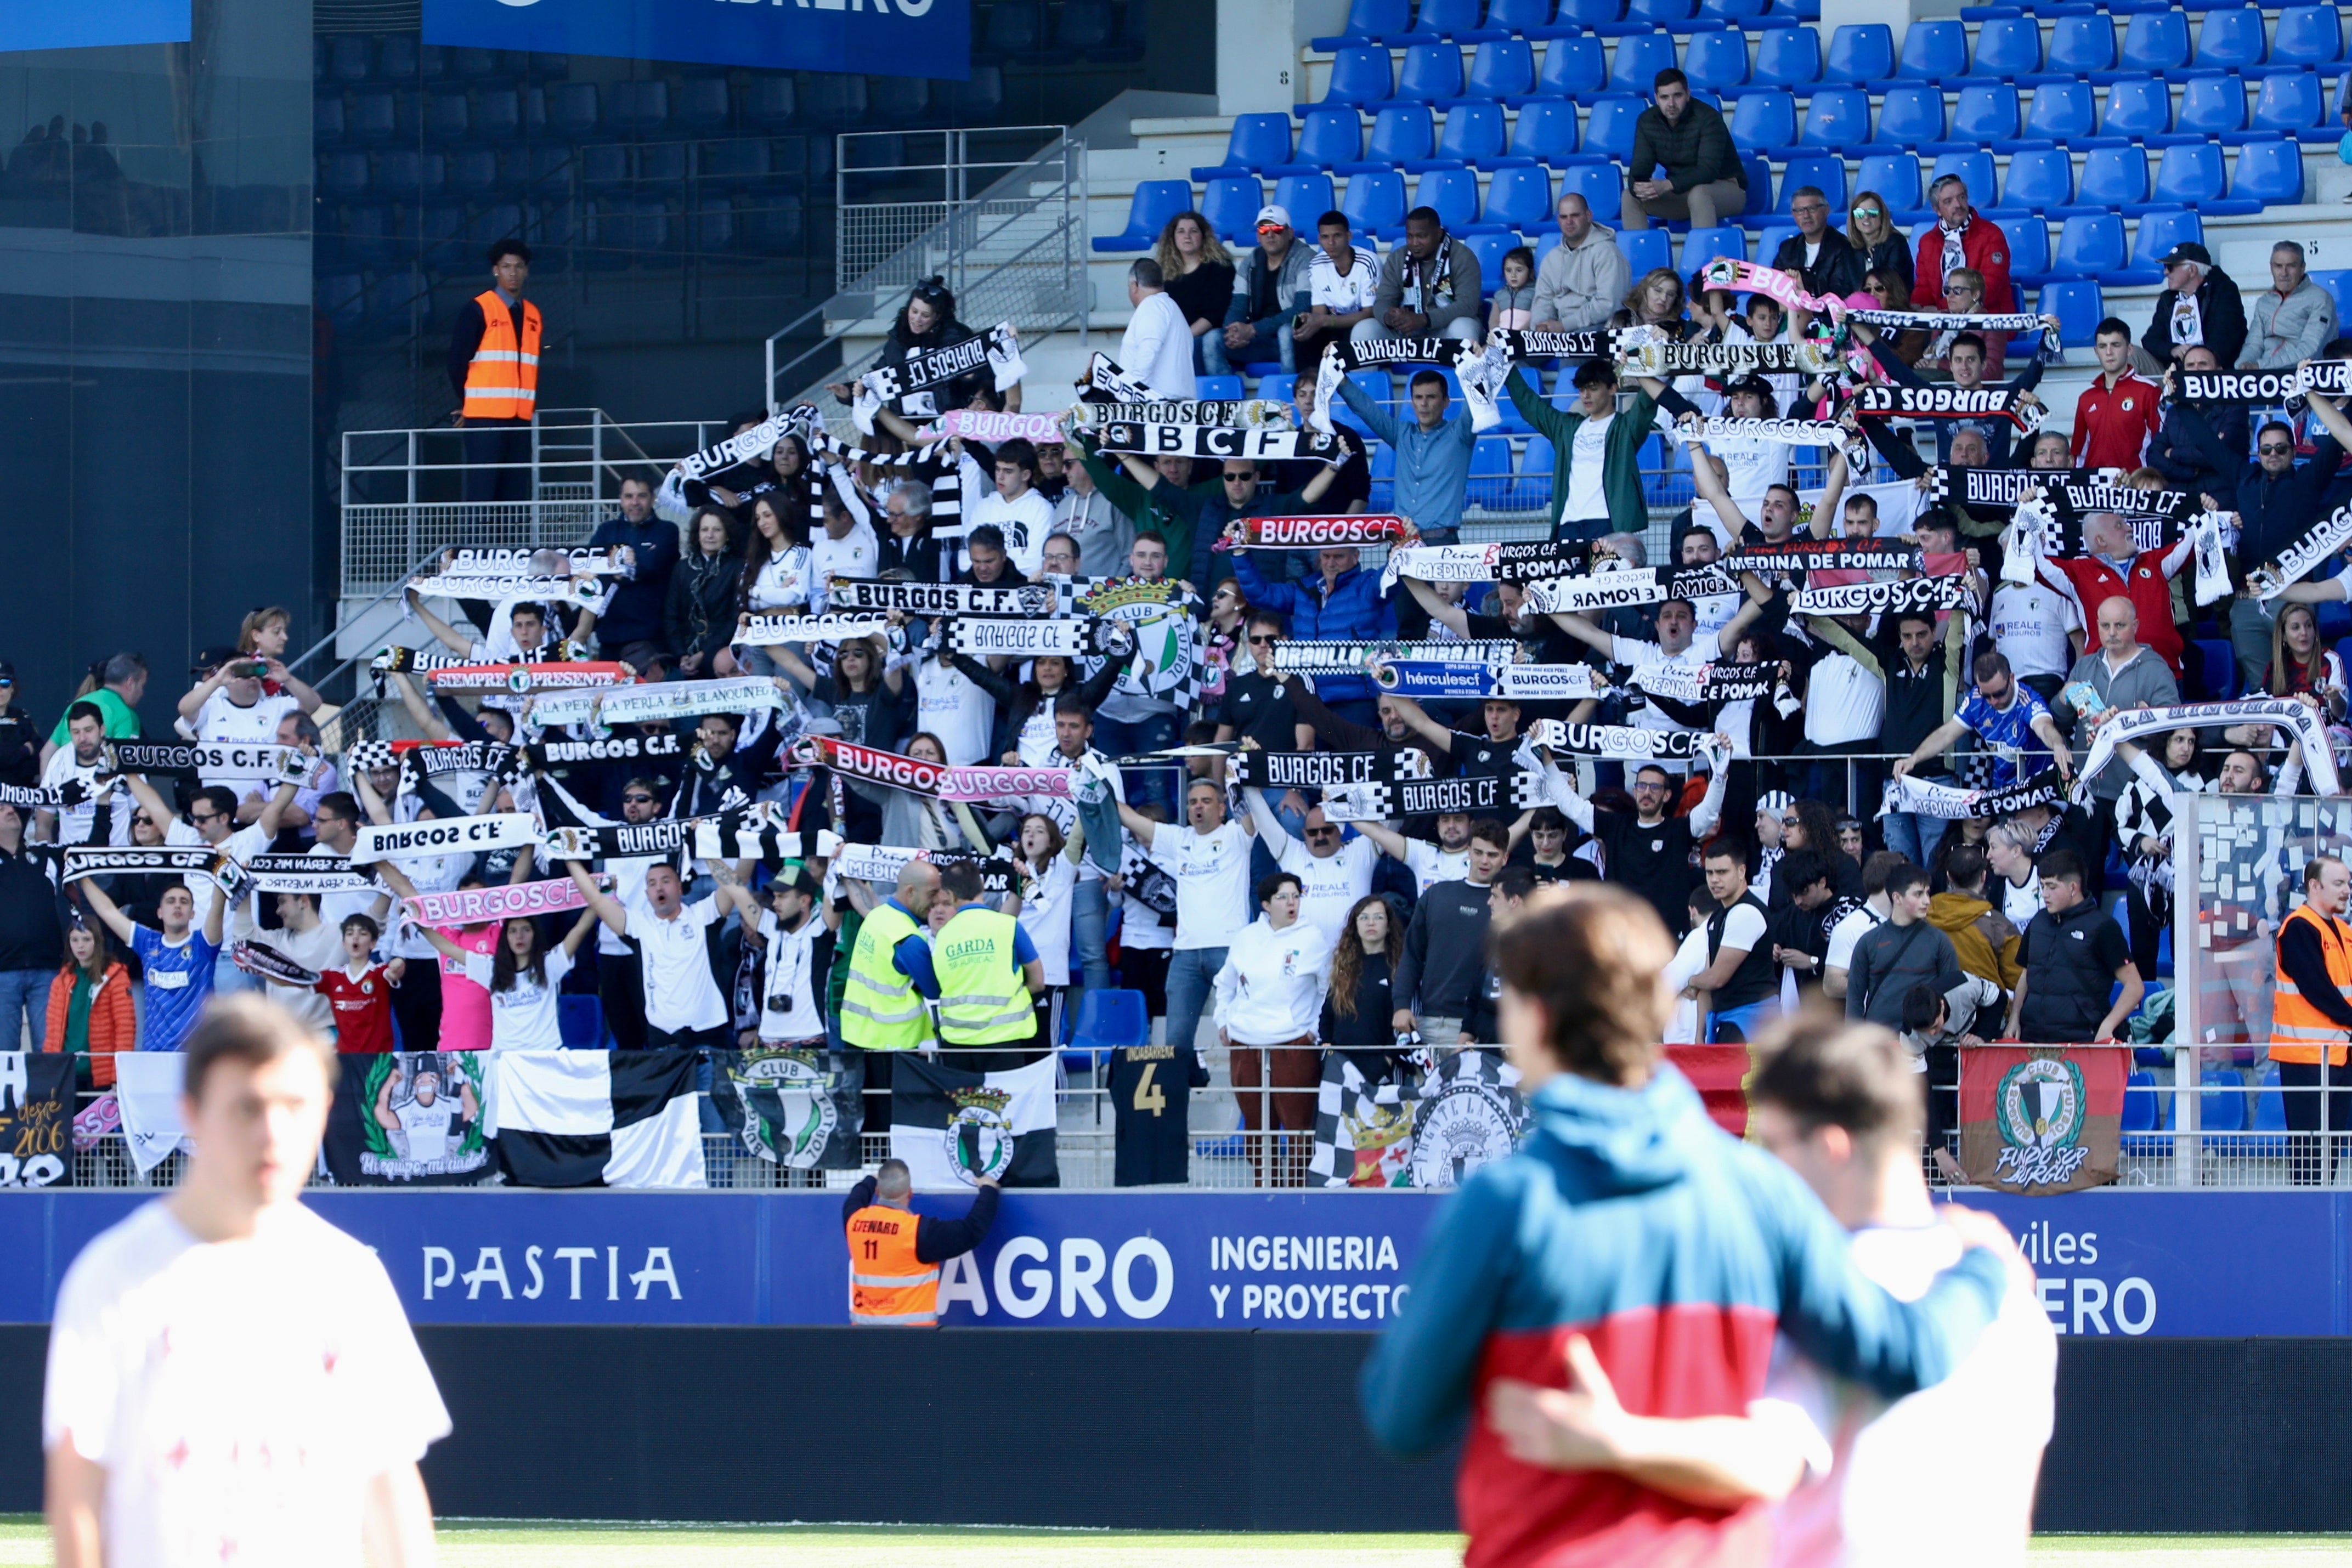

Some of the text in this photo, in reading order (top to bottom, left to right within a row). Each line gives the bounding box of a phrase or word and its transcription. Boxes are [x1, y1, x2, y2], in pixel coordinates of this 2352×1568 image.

[1520, 331, 1577, 353] BURGOS
[908, 337, 986, 388] BURGOS CF
[1864, 387, 2009, 411] BURGOS CF
[957, 410, 1060, 435] BURGOS
[1727, 452, 1759, 461] REALE
[2066, 485, 2186, 514] BURGOS CF
[1442, 547, 1482, 559] Peña
[1483, 545, 1538, 565] BURGOS
[1729, 552, 1909, 571] MEDINA DE POMAR
[1416, 562, 1488, 579] MEDINA
[1517, 556, 1581, 579] POMAR
[857, 584, 1014, 612] BURGOS C.F.
[1112, 605, 1153, 620] CLUB
[2008, 621, 2042, 630] REALE
[1168, 623, 1189, 679] FUTBOL
[1274, 646, 1365, 667] ORGULLO
[437, 672, 507, 689] SIEMPRE
[530, 671, 616, 688] PRESENTE
[1638, 673, 1697, 698] MEDINA
[543, 700, 562, 713] LA
[565, 697, 594, 713] PER
[604, 684, 782, 712] LA PERLA BLANQUINEGR
[1030, 722, 1056, 732] REAL
[2119, 711, 2157, 730] LA
[118, 744, 273, 768] BURGOS C.F.
[420, 746, 511, 774] BURGOS CF
[545, 734, 681, 763] BURGOS C.F.
[1268, 755, 1376, 784] BURGOS CF
[1403, 779, 1499, 812] BURGOS CF
[1991, 785, 2057, 816] POMAR
[67, 851, 208, 874] URGOS CF
[847, 859, 900, 878] MEDIN
[1312, 881, 1350, 892] REALE
[945, 938, 994, 958] GARDA
[760, 1062, 799, 1077] CLUB
[2027, 1062, 2060, 1077] CLUB
[1132, 1062, 1167, 1117] 4
[2009, 1087, 2033, 1139] BURGOS
[2050, 1087, 2074, 1137] FUTBOL
[13, 1119, 65, 1158] 2006
[852, 1219, 899, 1237] STEWARD
[863, 1239, 878, 1260] 11
[1211, 1235, 1399, 1271] INGENIERIA
[421, 1244, 682, 1301] PASTIA
[936, 1235, 1174, 1320] AGRO
[1209, 1284, 1231, 1319] Y
[2036, 1276, 2157, 1336] ERO
